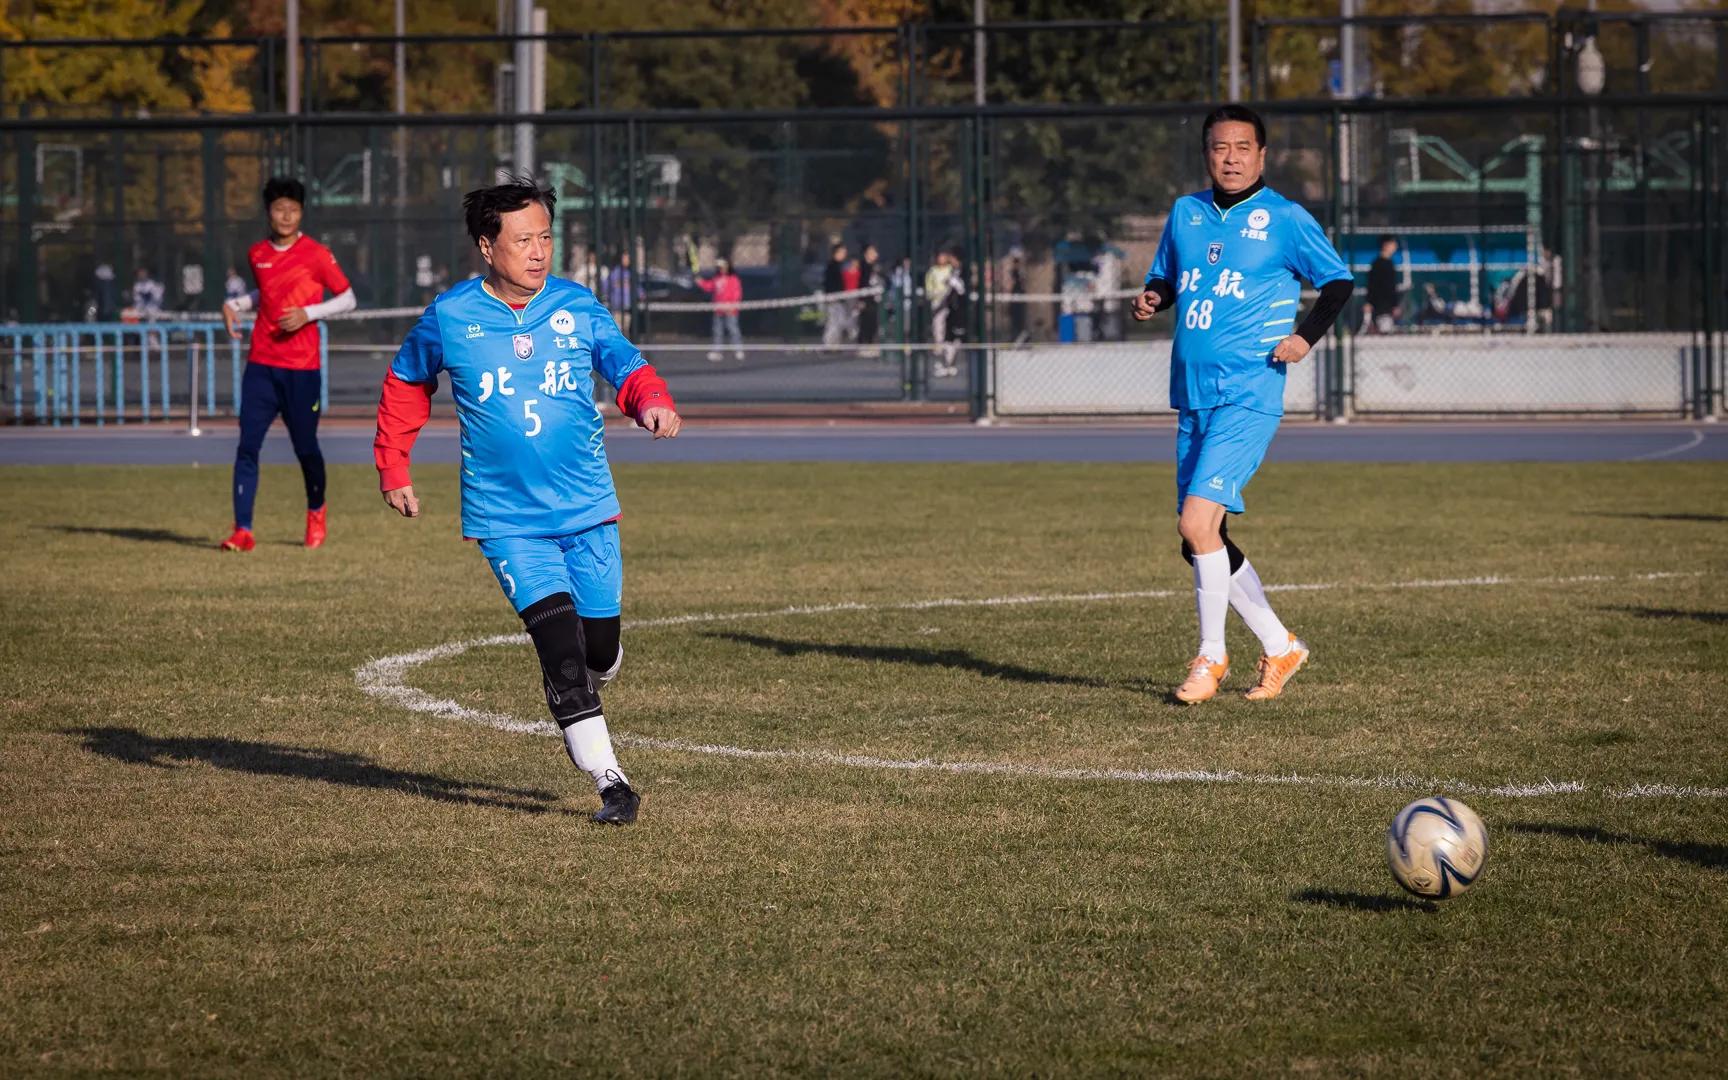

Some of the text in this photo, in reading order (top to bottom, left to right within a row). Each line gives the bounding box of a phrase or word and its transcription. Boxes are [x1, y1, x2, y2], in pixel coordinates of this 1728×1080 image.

[1178, 267, 1245, 299] 北航
[1185, 299, 1214, 330] 68
[552, 336, 579, 349] 七系
[478, 361, 577, 403] 北航
[523, 399, 542, 437] 5
[499, 560, 516, 598] 5
